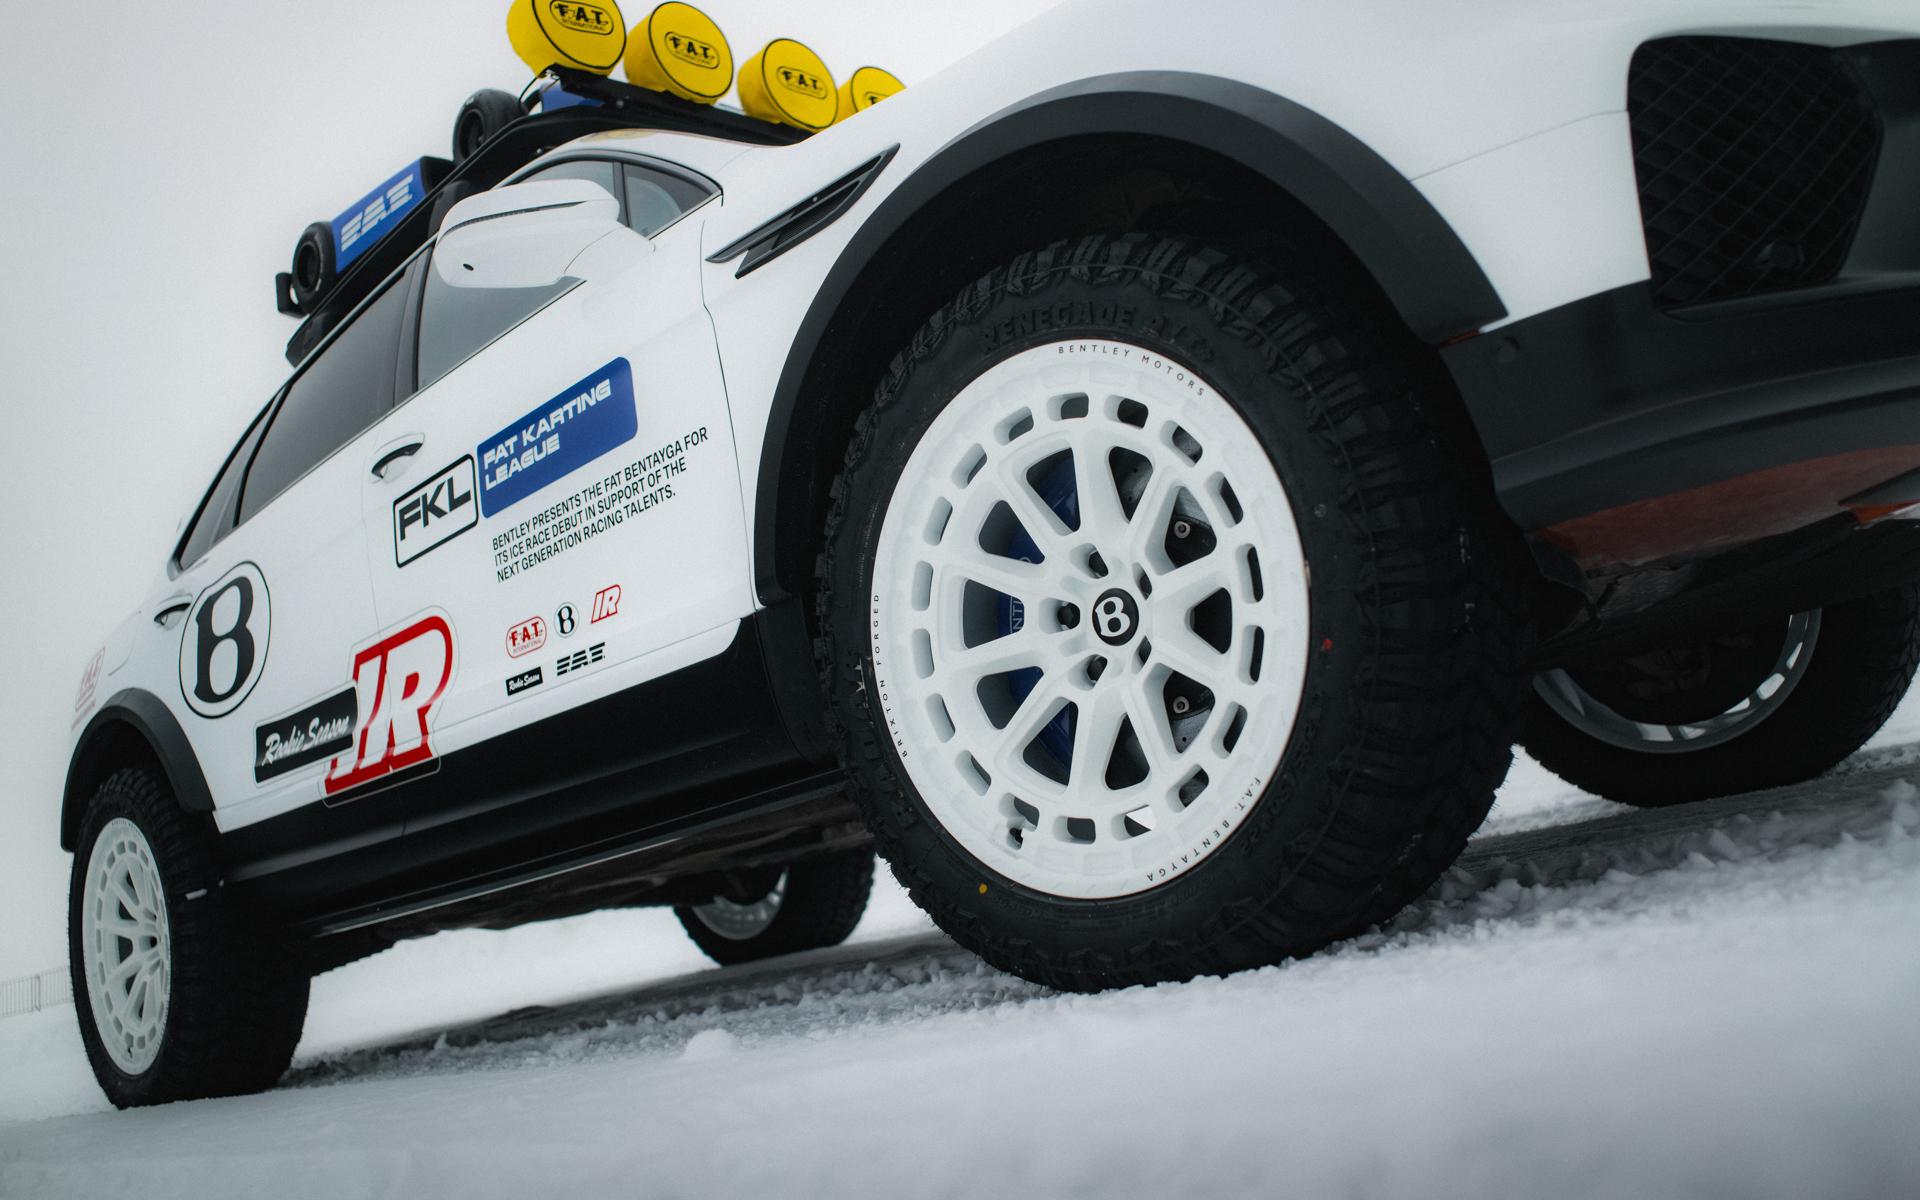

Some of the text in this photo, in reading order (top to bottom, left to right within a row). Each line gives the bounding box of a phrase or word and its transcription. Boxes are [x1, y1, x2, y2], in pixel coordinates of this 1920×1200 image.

[1058, 344, 1205, 397] BENTLEY MOTORS
[483, 378, 612, 471] FAT KARTING
[485, 433, 561, 491] LEAGUE
[398, 476, 472, 542] FKL
[492, 426, 708, 551] BENTLEY PRESENTS THE FAT BENTAYGA FOR
[494, 456, 687, 567] ITS ICE RACE DEBUT IN SUPPORT OF THE
[496, 483, 676, 583] NEXT GENERATION RACING TALENTS.
[873, 594, 908, 758] BRIXTON FORGED
[261, 715, 350, 767] Rookie Season
[1146, 819, 1230, 882] BENTAYGA
